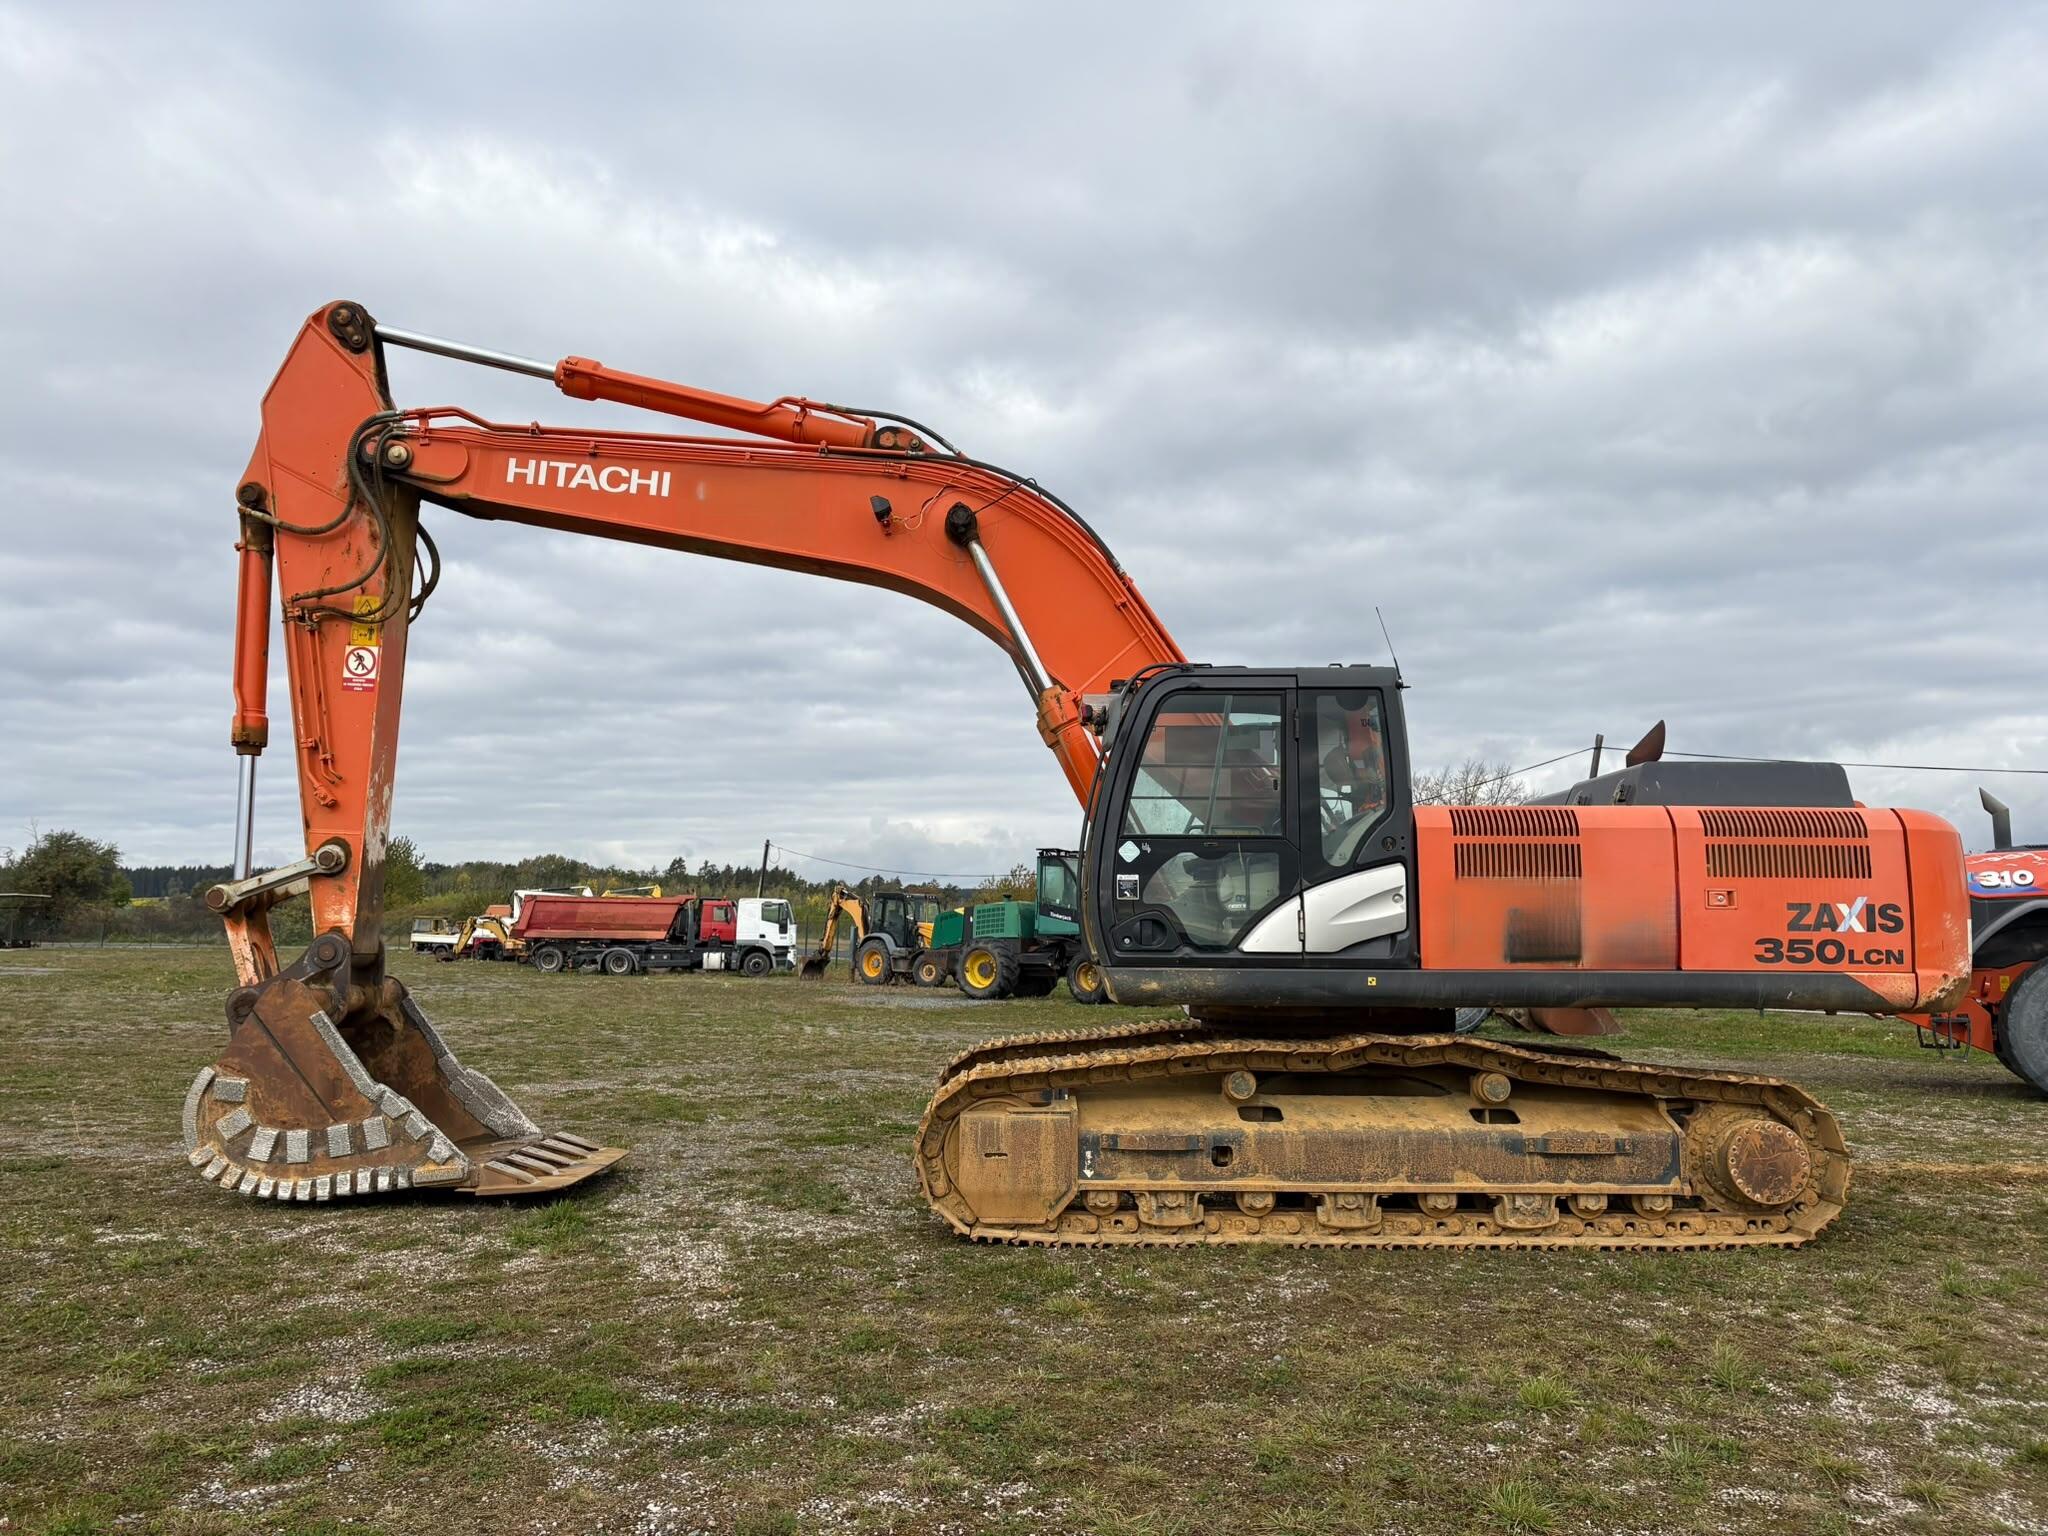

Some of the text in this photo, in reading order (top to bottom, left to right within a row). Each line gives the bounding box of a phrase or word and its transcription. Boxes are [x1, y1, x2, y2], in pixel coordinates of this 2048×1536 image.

[506, 457, 671, 497] HITACHI
[1980, 869, 2034, 888] 310
[1786, 896, 1904, 933] ZAXIS
